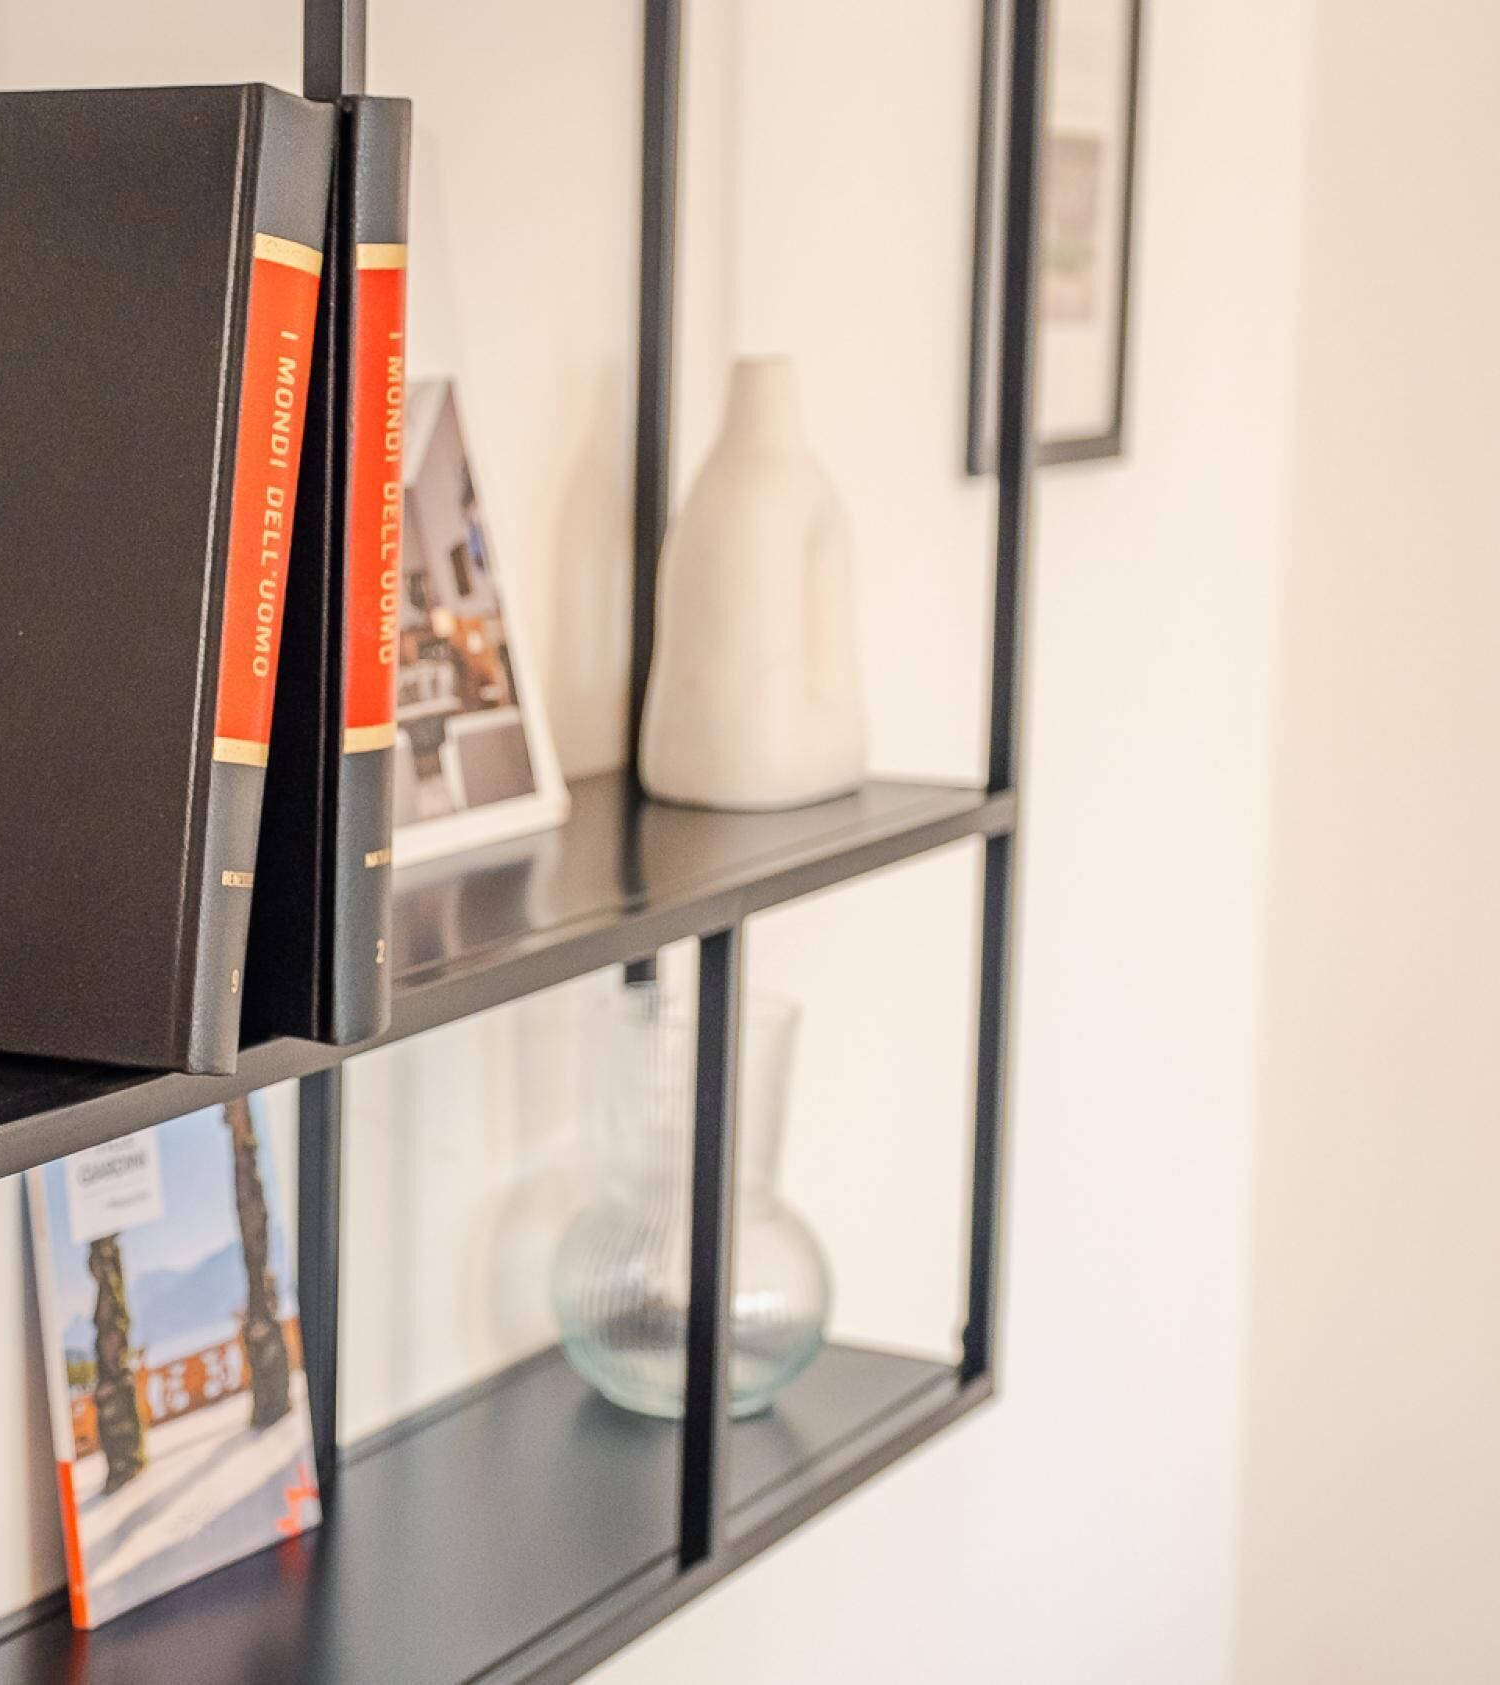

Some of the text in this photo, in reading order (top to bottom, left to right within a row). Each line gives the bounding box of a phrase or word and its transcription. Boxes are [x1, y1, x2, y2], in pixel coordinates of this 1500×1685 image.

[252, 331, 300, 679] I MONDI DELL'UOMO
[384, 355, 405, 463] MONDI
